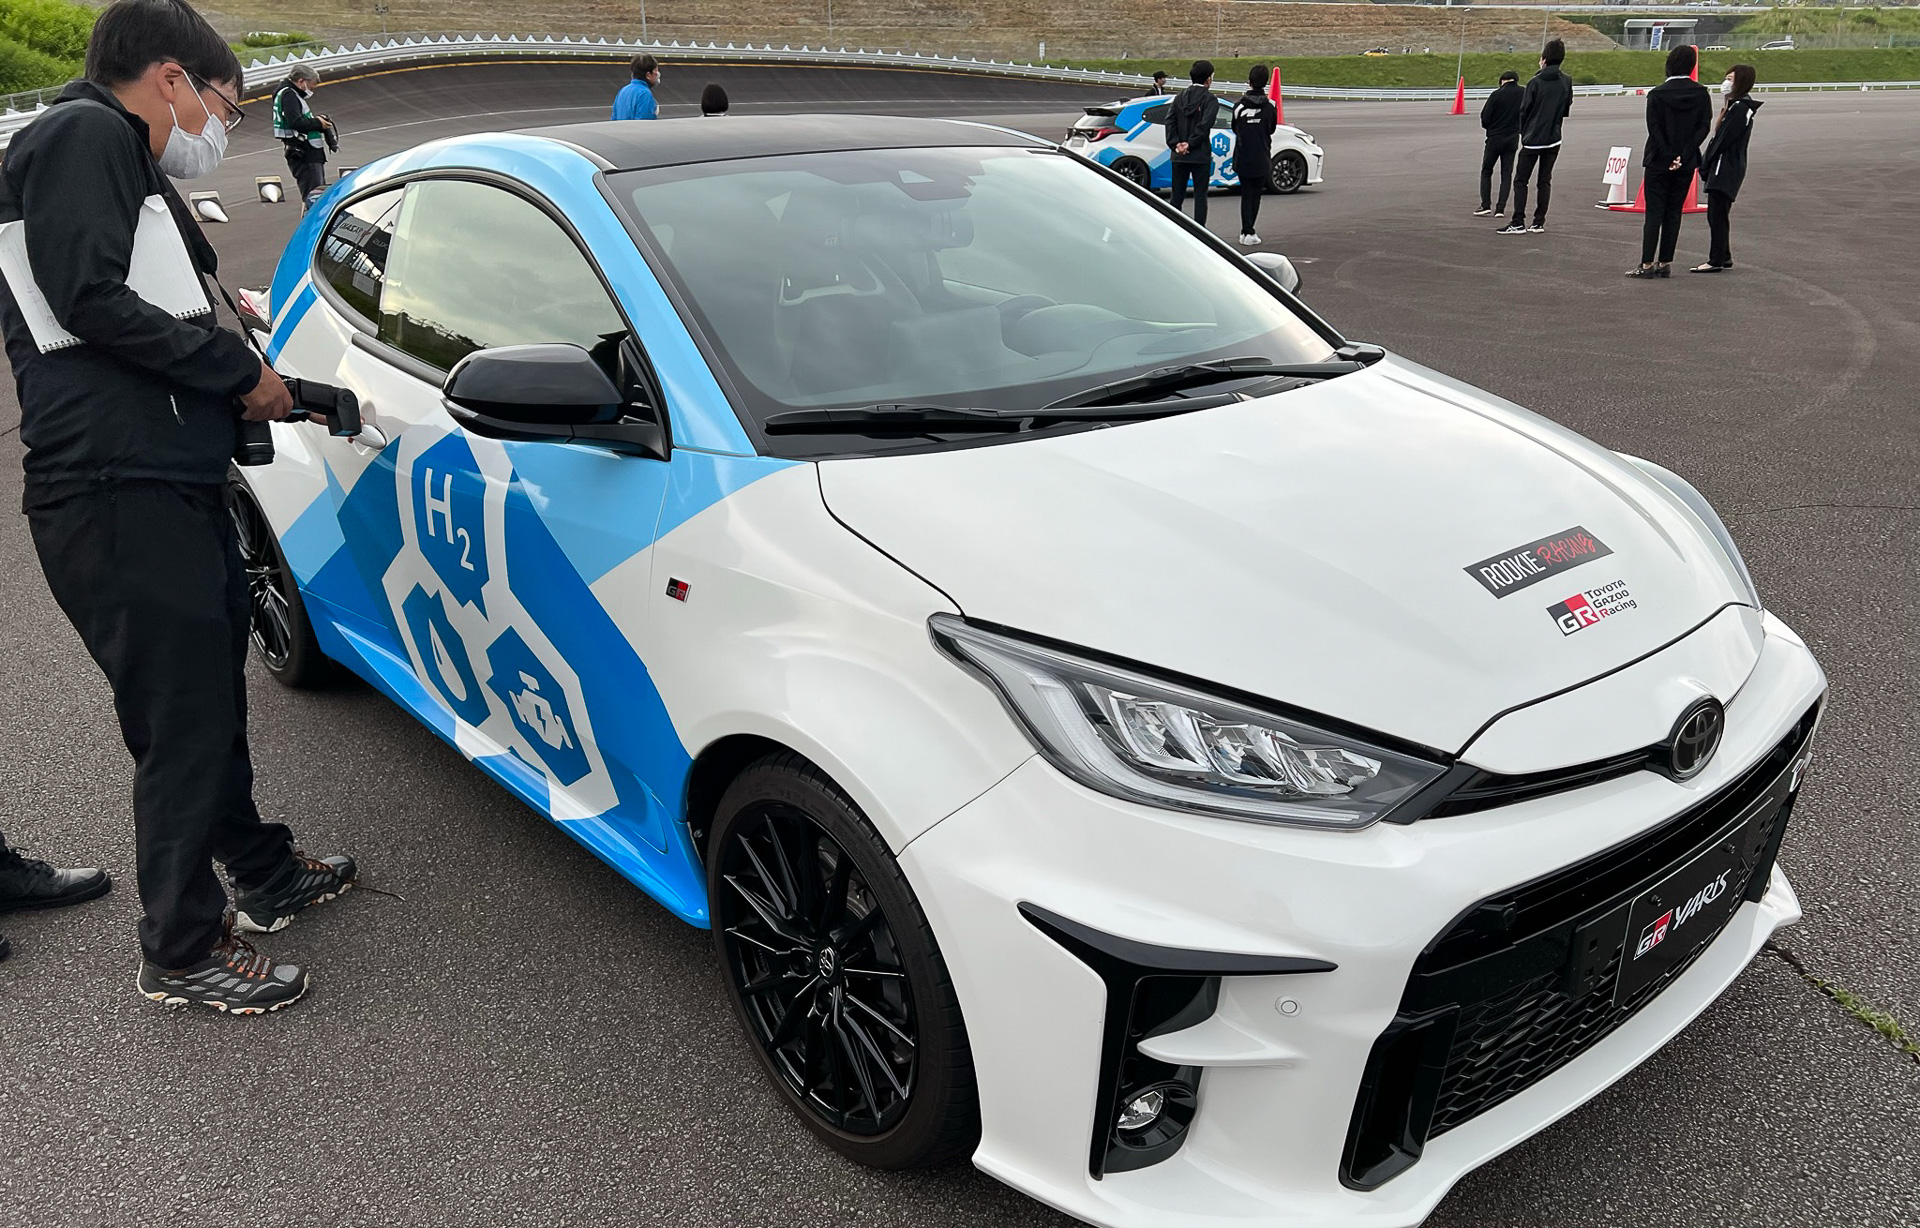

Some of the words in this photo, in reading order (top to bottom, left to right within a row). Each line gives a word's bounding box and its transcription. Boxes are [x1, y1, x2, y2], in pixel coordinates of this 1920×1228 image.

[1606, 157, 1627, 174] STOP
[425, 467, 475, 571] H2
[1479, 550, 1547, 590] ROOKIE
[1536, 532, 1596, 566] RACING
[667, 585, 686, 600] GR
[1584, 579, 1627, 600] TOYOTA
[1592, 589, 1630, 609] GAZOO
[1599, 599, 1638, 619] Racing
[1557, 605, 1600, 635] GR
[1636, 923, 1668, 956] GR
